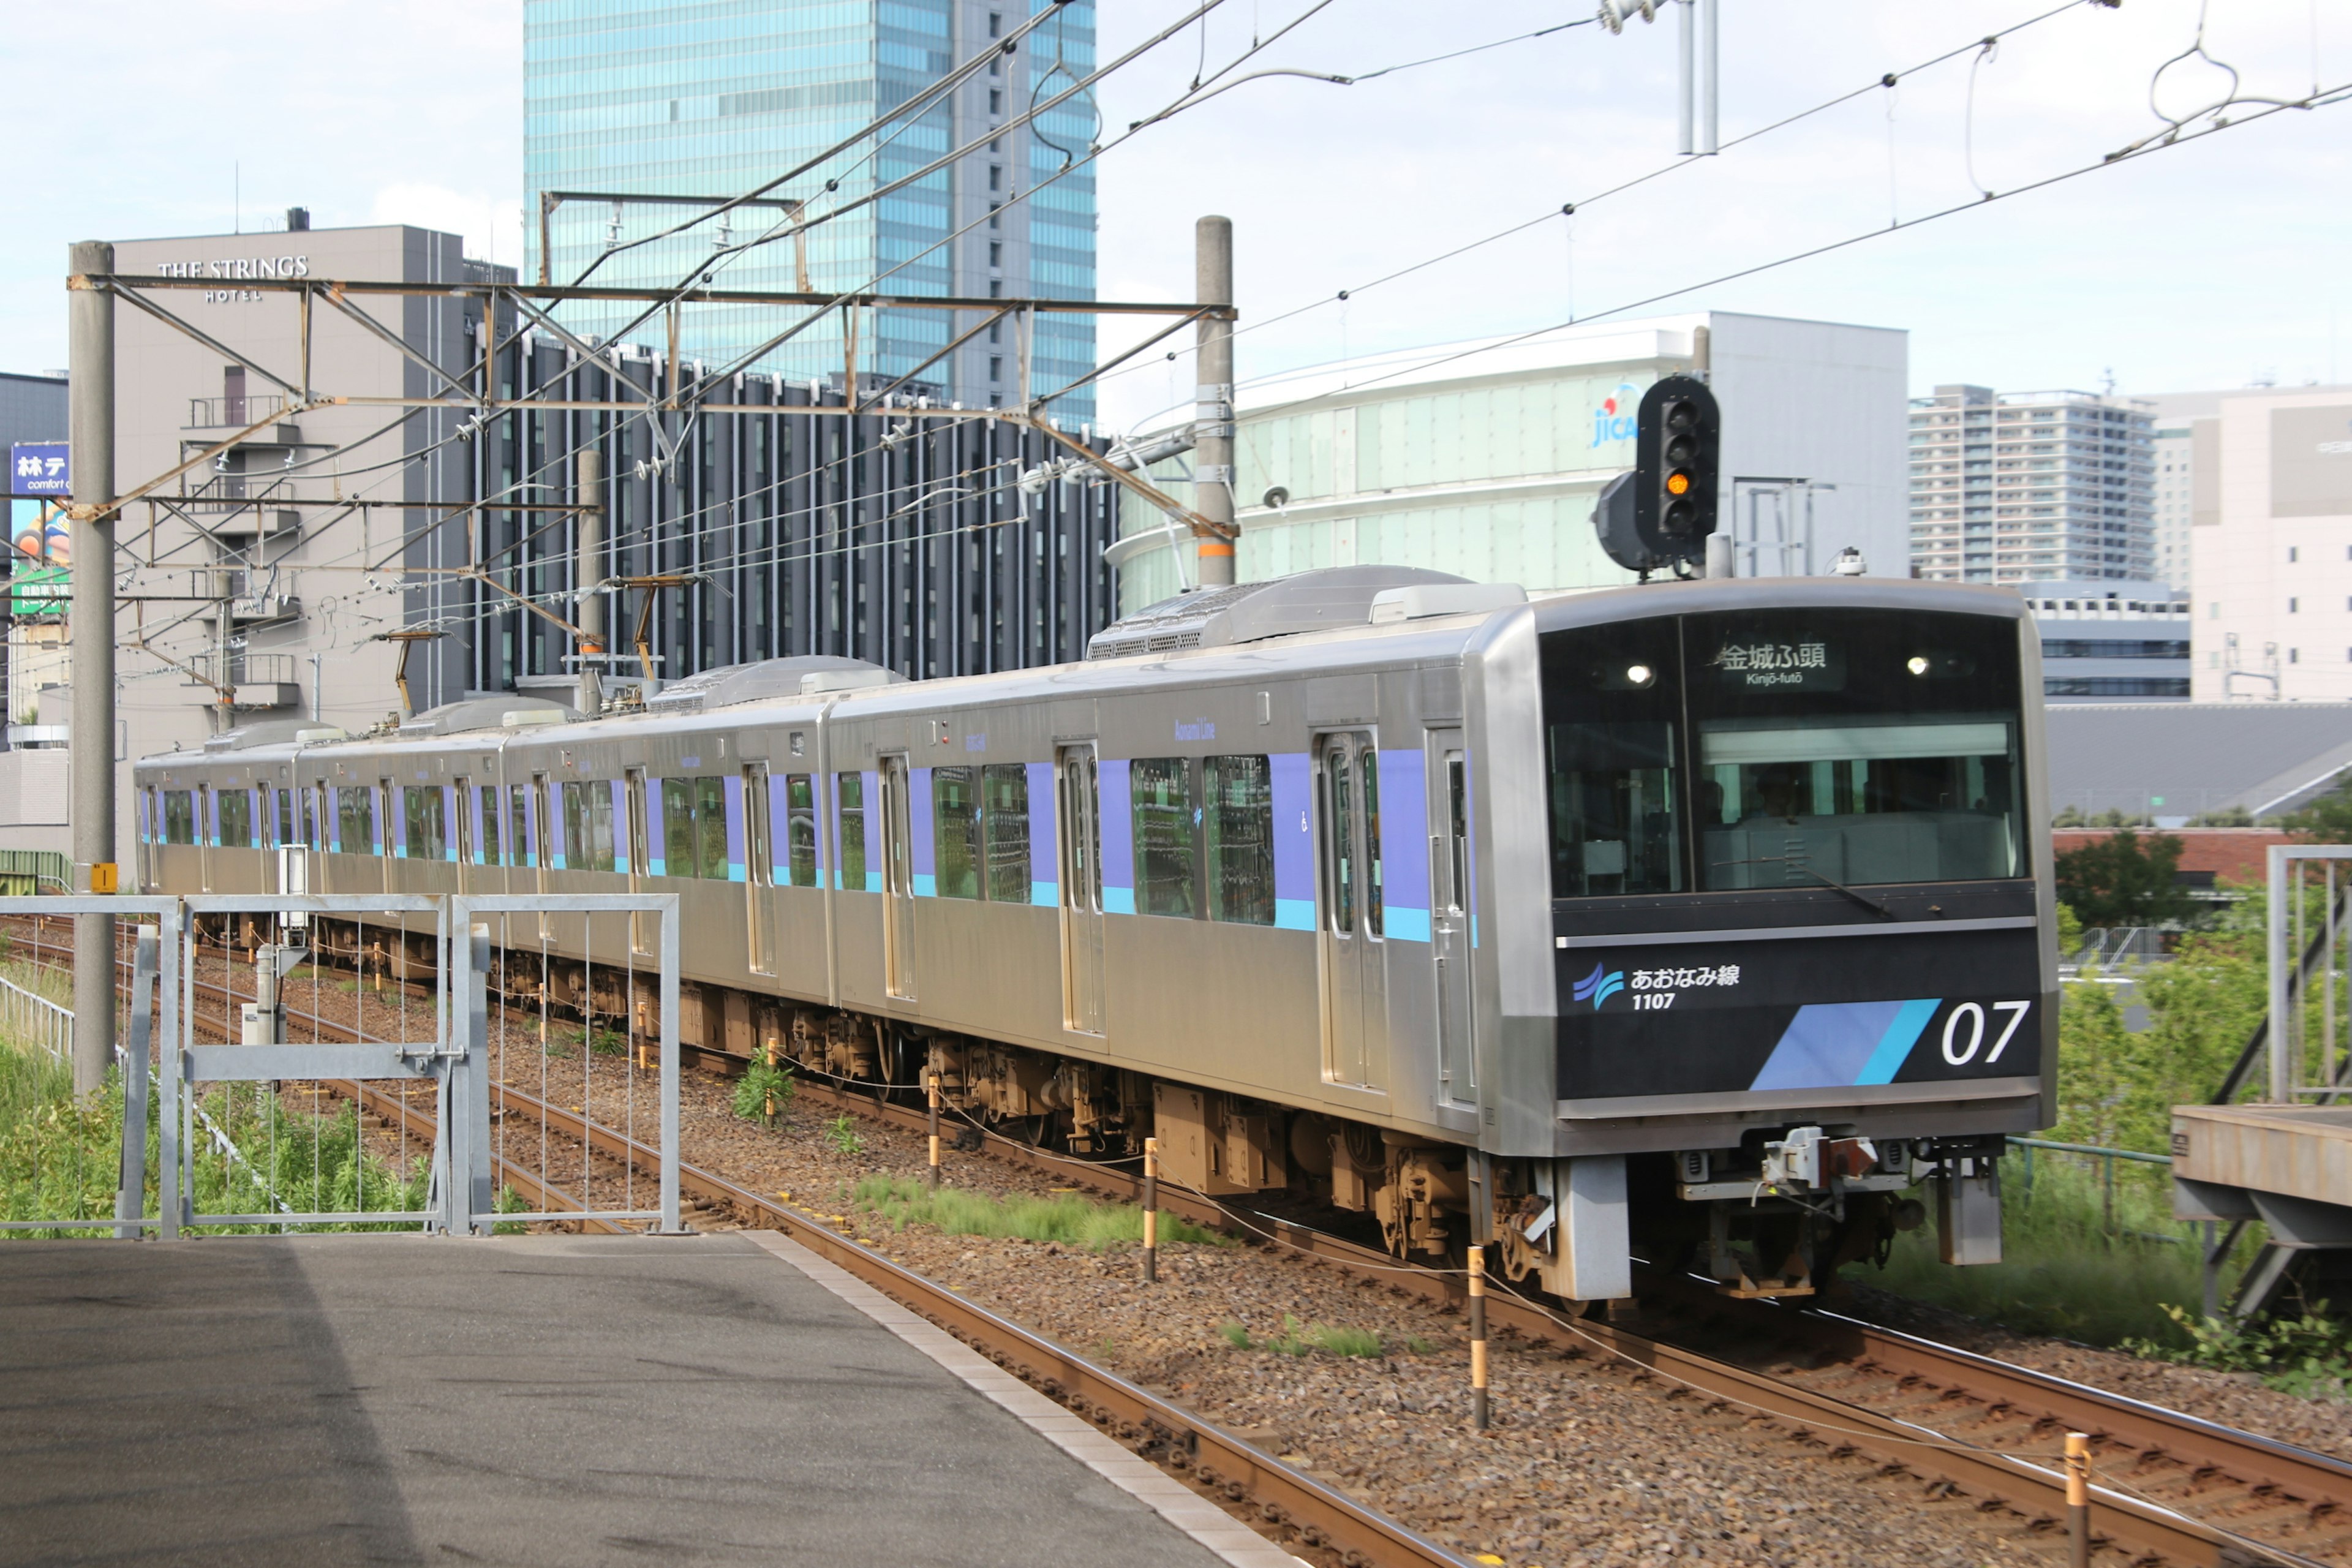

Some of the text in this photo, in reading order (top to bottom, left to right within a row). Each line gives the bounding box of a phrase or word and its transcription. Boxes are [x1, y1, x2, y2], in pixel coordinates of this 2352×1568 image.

[158, 255, 309, 279] THE STRINGS
[206, 289, 262, 303] HOTEL
[28, 478, 64, 490] comfort
[1723, 643, 1826, 670] 金城ふ頭
[1747, 671, 1803, 687] Kinjō-futō
[1630, 964, 1741, 990] あおなみ線
[1632, 992, 1676, 1010] 1107
[1942, 1000, 2031, 1066] 07
